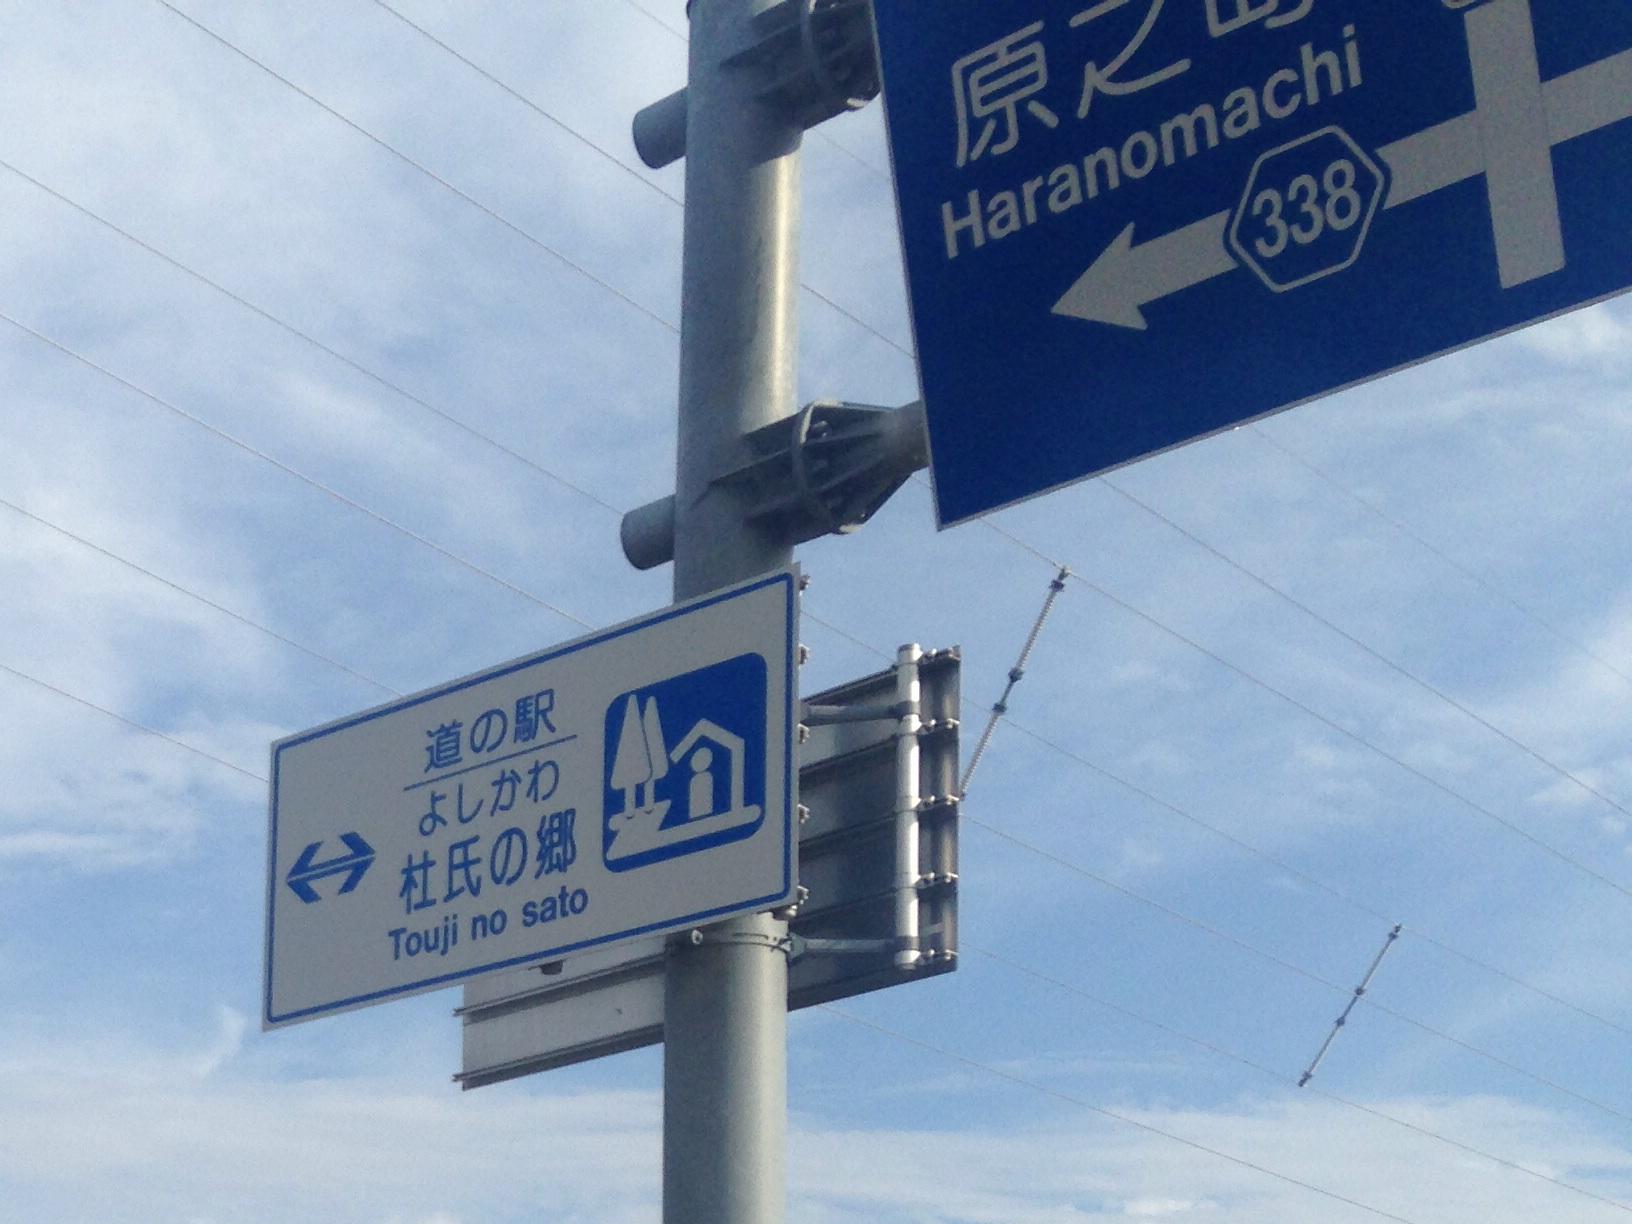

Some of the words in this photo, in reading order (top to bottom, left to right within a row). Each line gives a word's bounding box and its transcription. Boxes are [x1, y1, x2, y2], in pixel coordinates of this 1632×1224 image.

[952, 0, 1314, 168] 原之
[942, 24, 1363, 259] Haranomachi
[1252, 159, 1361, 257] 338
[424, 689, 556, 773] 道の駅
[419, 760, 560, 836] よしかわ
[399, 808, 576, 914] 杜氏の郷
[388, 913, 458, 960] Touji
[471, 909, 507, 941] no
[522, 885, 589, 928] sato
